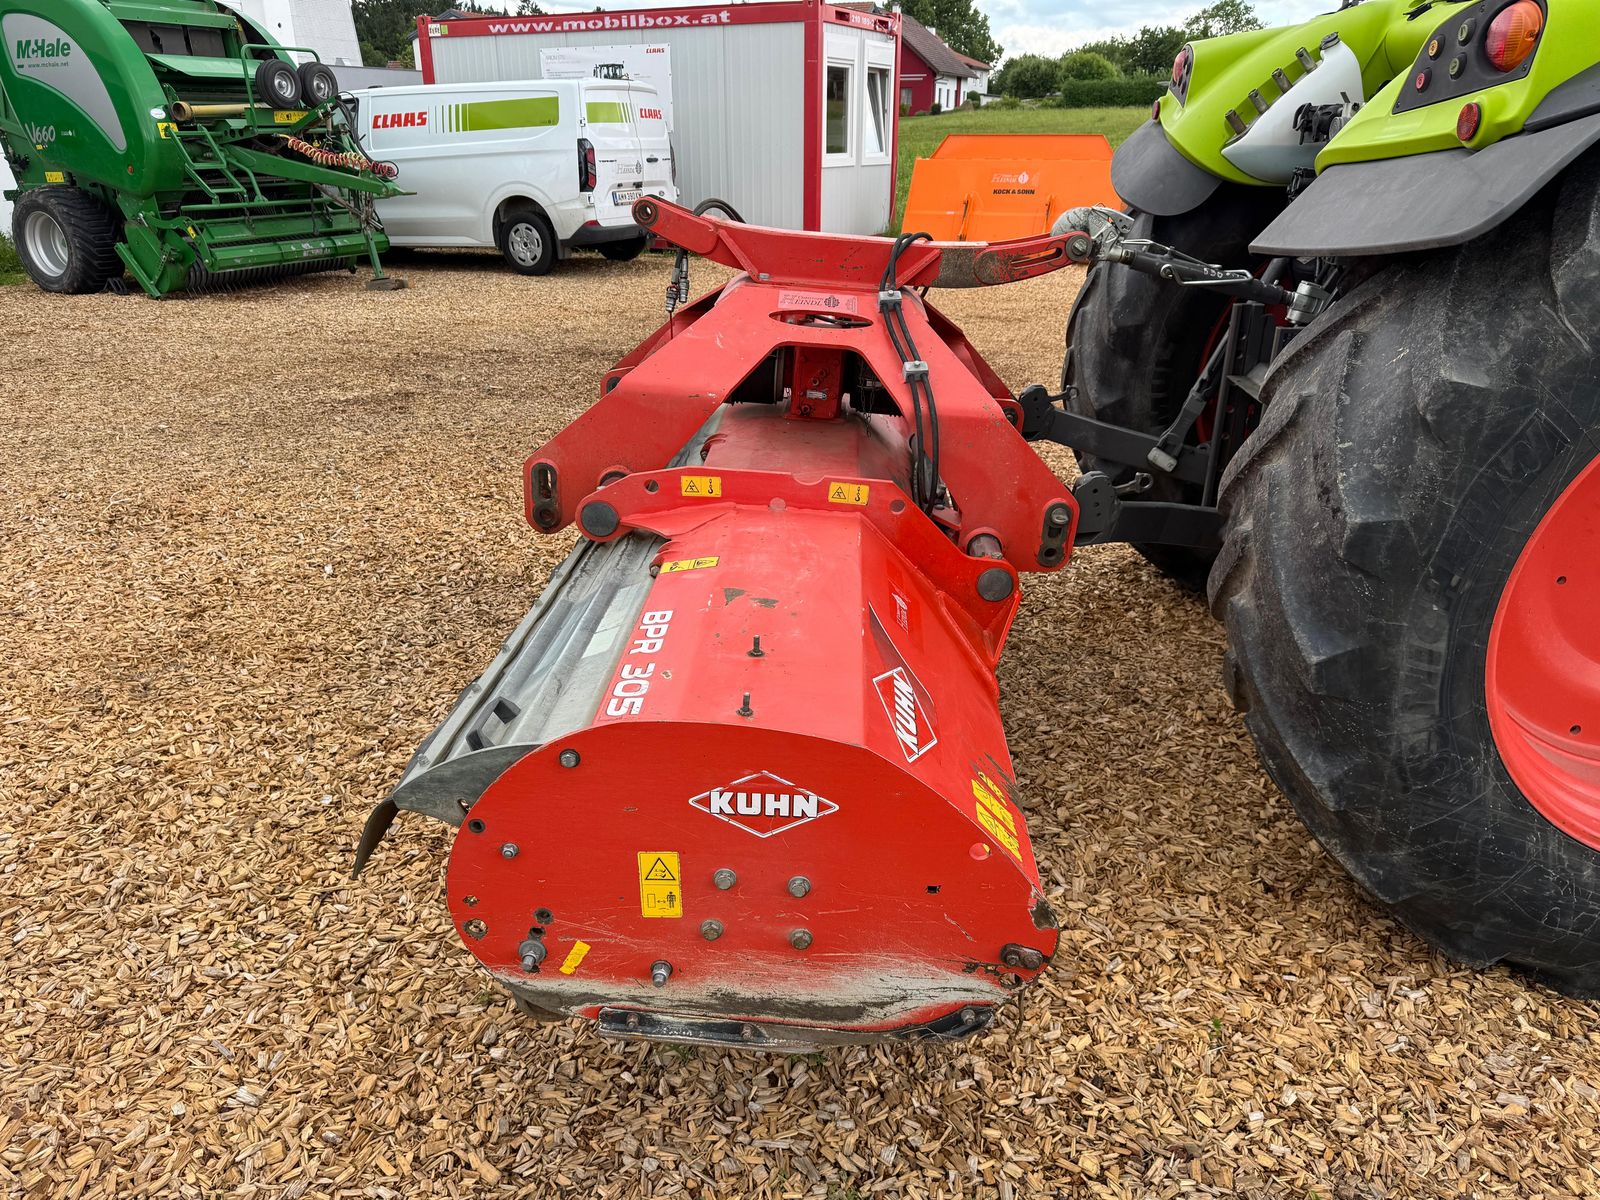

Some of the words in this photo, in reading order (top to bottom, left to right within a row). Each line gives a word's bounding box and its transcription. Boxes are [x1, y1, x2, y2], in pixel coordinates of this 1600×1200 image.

[488, 10, 731, 34] www.mobilbox.at
[16, 38, 71, 59] McHale
[372, 111, 428, 129] CLAAS
[640, 107, 662, 119] CLAAS
[24, 121, 56, 144] V660
[629, 610, 674, 655] BPR
[606, 662, 656, 716] 305
[893, 671, 920, 756] KUHN
[709, 791, 819, 818] KUHN
